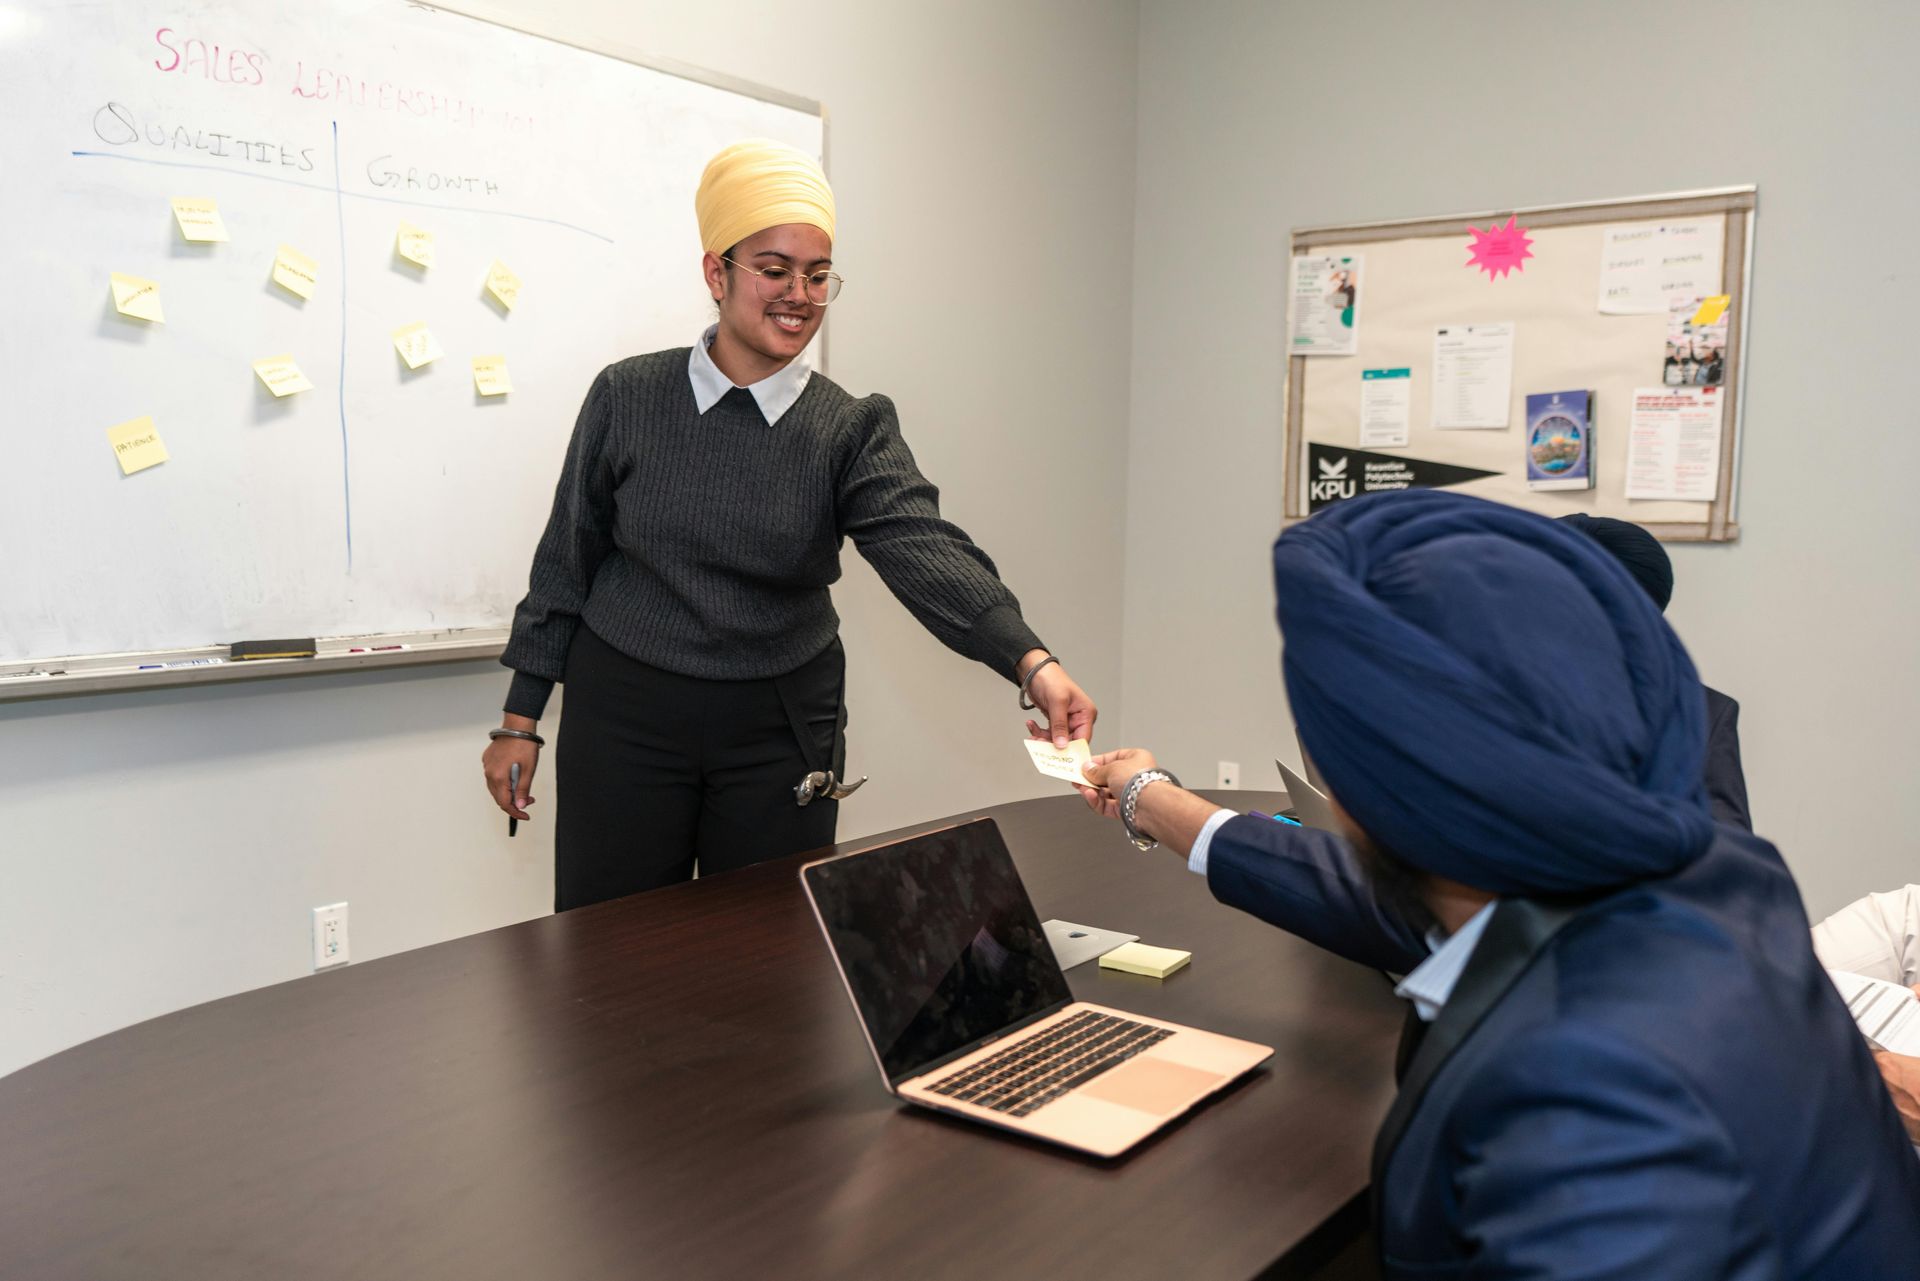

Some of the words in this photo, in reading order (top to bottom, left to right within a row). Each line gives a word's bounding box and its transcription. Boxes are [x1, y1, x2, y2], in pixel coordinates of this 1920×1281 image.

[154, 27, 264, 86] SALES
[93, 102, 315, 172] QUALITIES
[366, 154, 499, 195] GROWTH
[1311, 480, 1356, 500] KPU
[1364, 471, 1415, 482] Polytechnic
